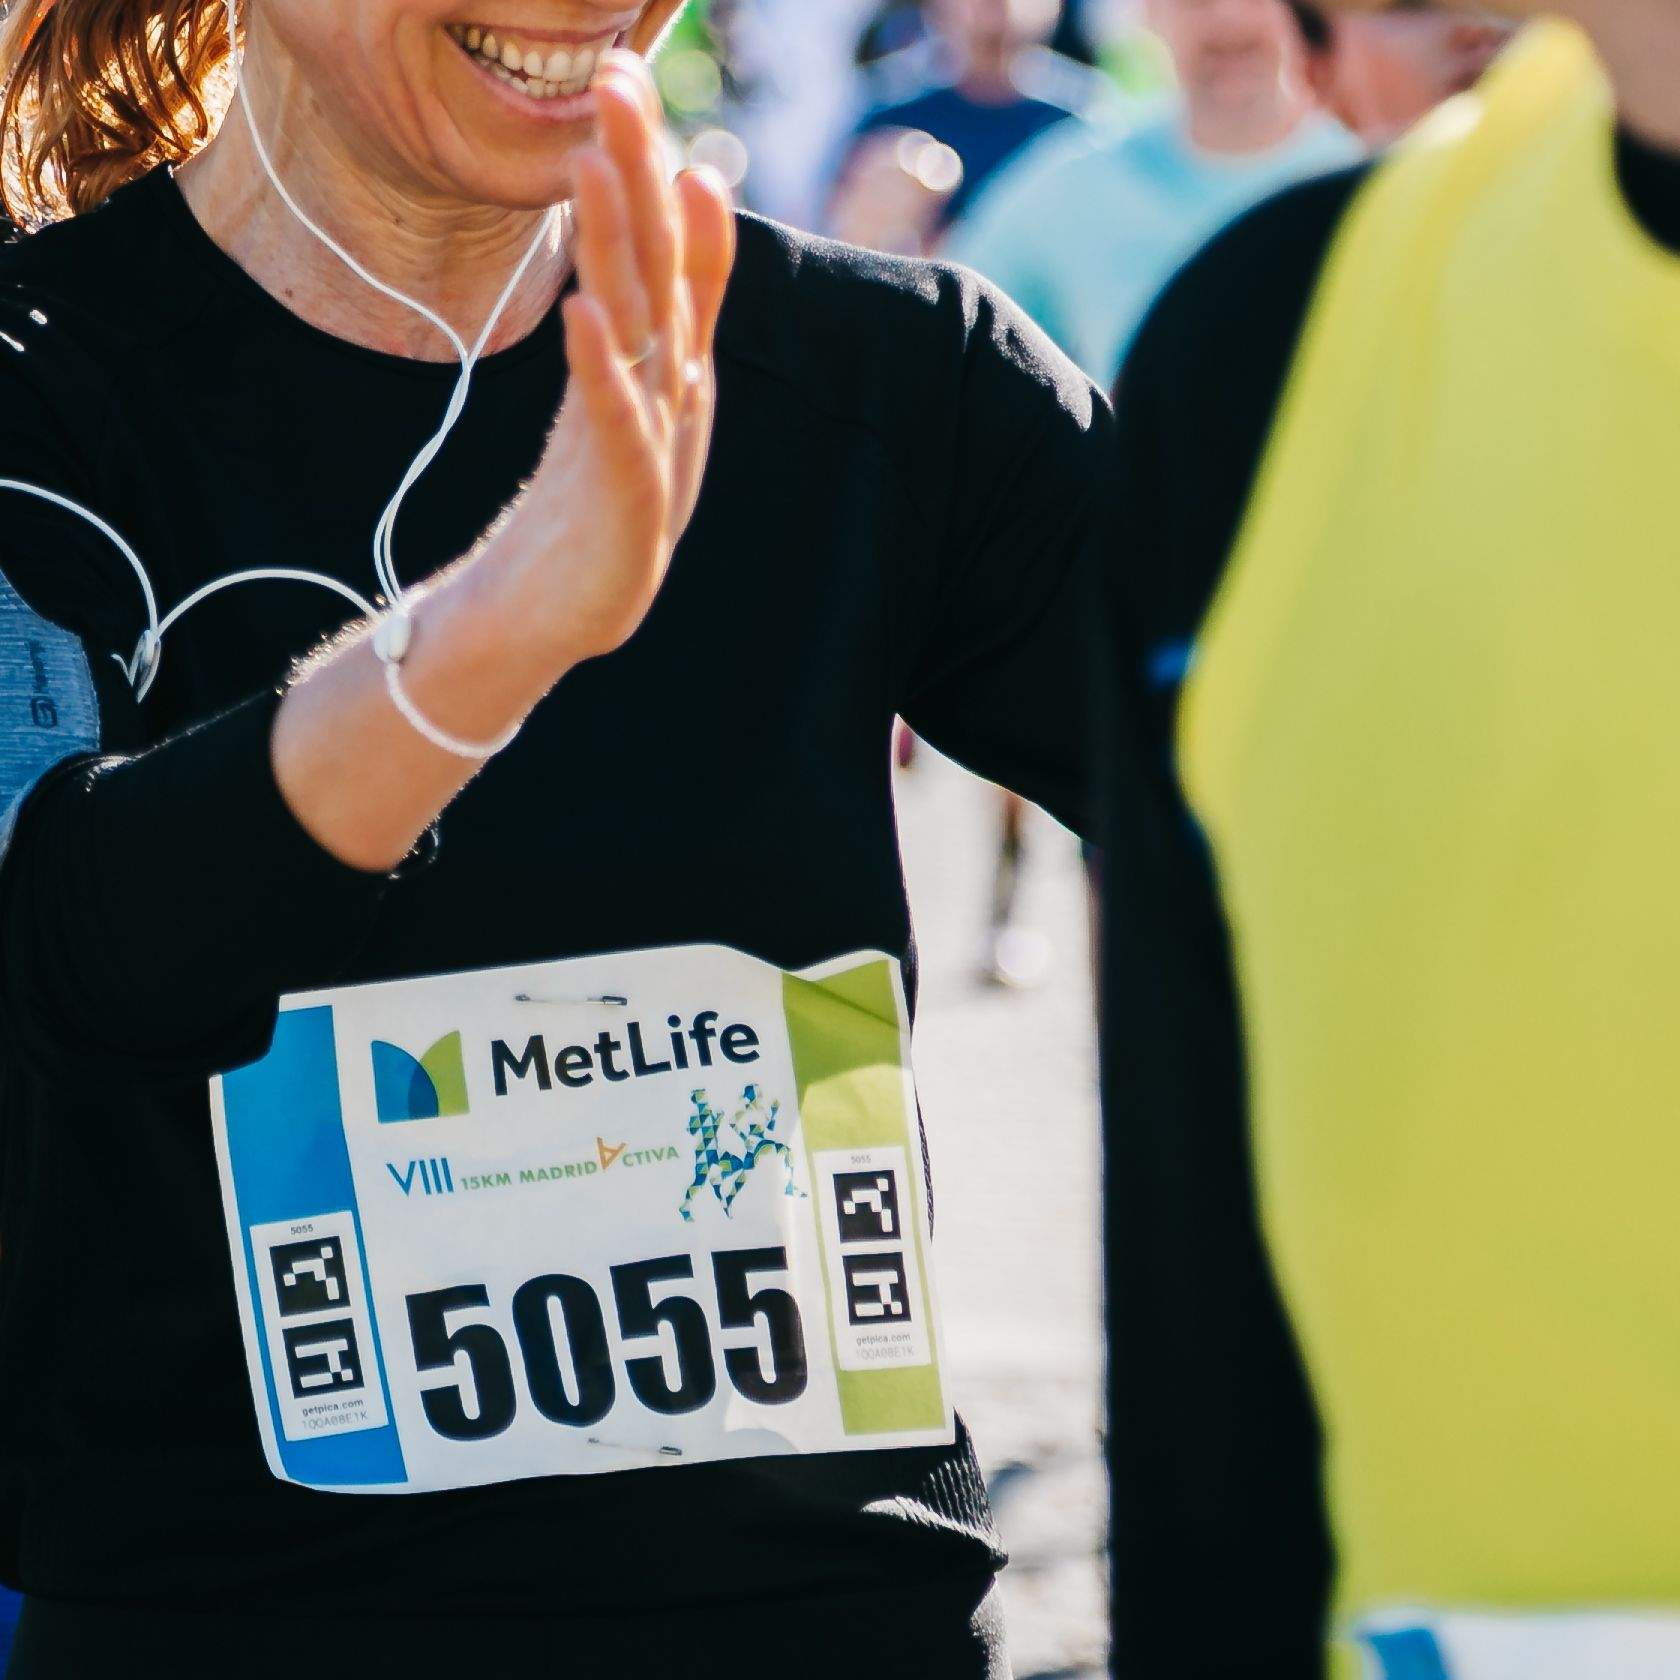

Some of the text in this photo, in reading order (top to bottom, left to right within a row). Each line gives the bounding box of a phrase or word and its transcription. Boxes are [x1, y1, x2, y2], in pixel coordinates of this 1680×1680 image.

[491, 1010, 761, 1096] MetLife
[386, 1157, 454, 1196] VIII
[461, 1173, 512, 1191] 15KM
[519, 1160, 598, 1183] MADRID
[290, 1224, 314, 1235] 5055
[405, 1246, 809, 1442] 5055
